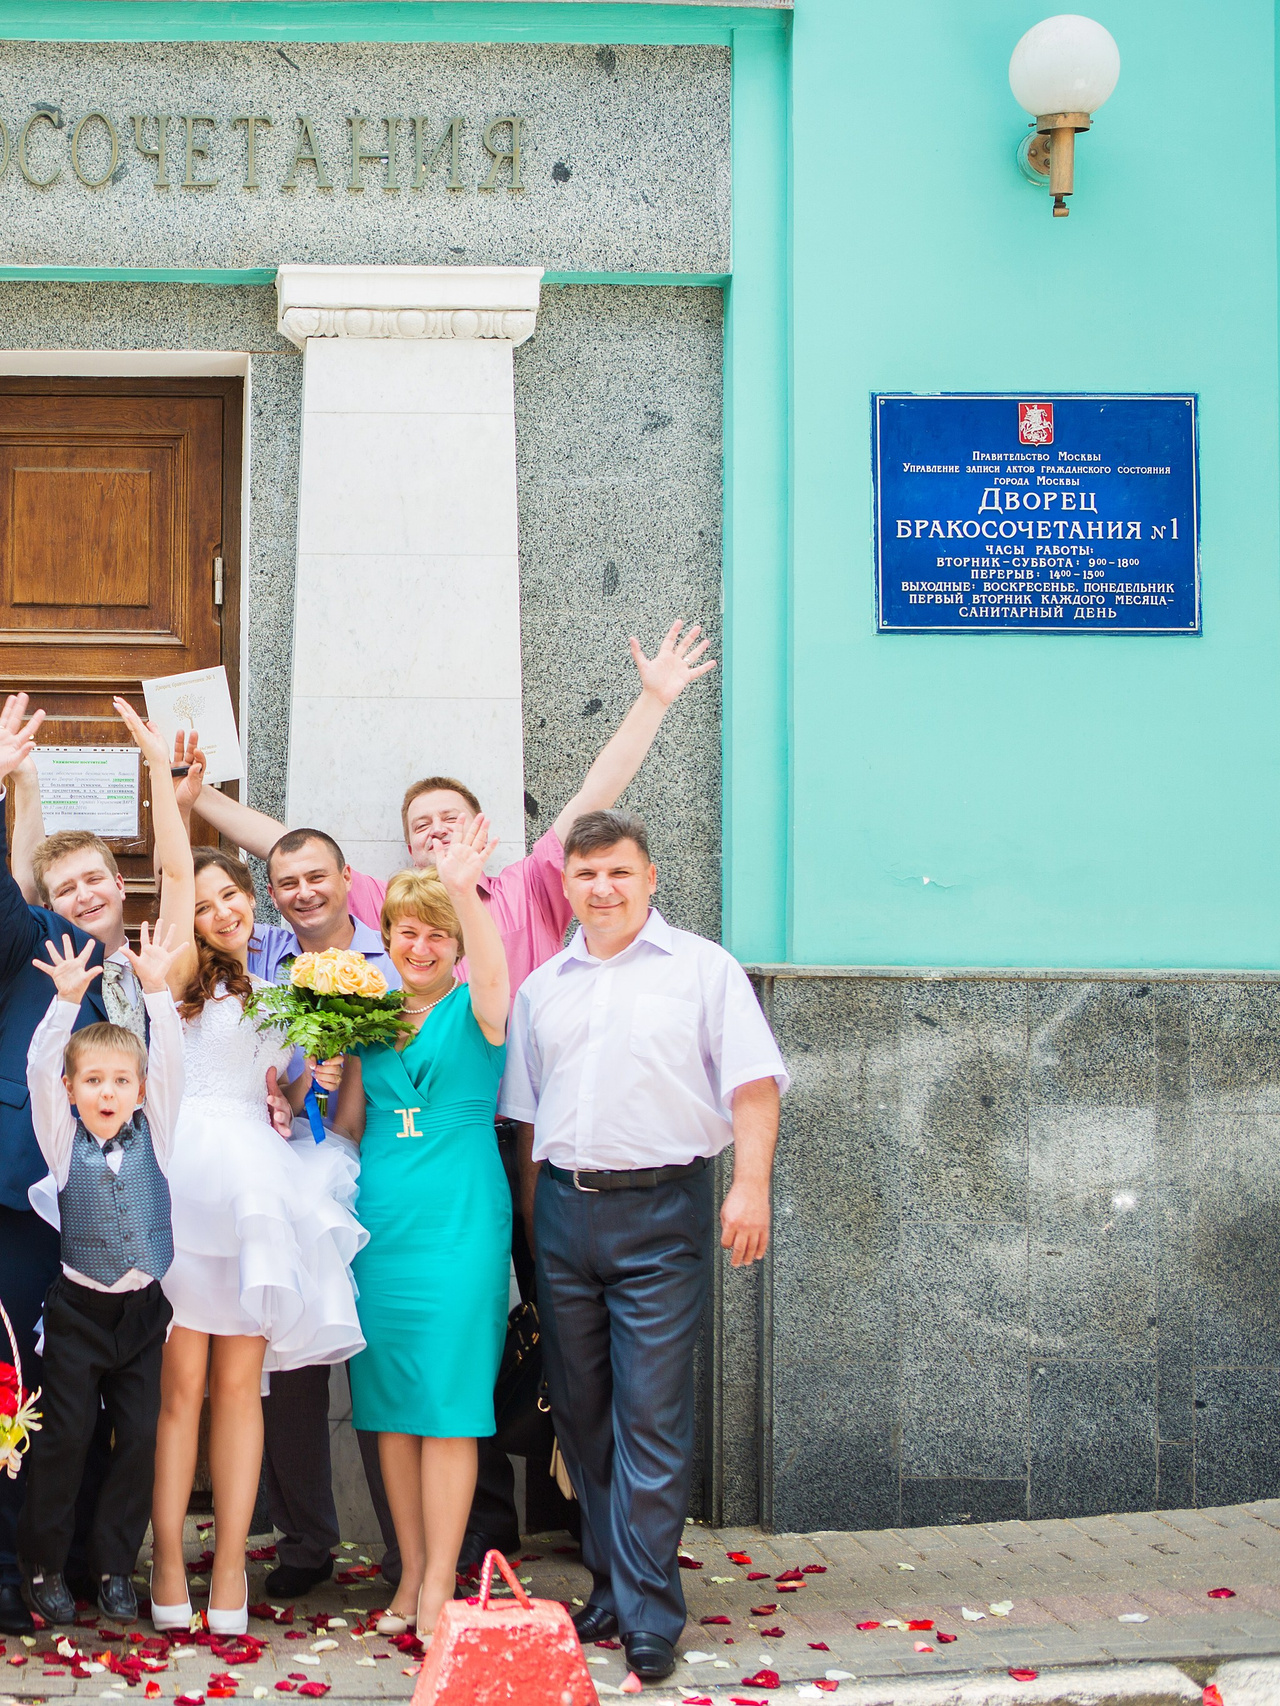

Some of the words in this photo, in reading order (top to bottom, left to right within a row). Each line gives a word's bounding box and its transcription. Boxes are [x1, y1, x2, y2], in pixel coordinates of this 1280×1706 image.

[896, 519, 1142, 540] БРАКОСОЧЕТАНИЯ
[985, 544, 1025, 555] ЧАСЫ
[1035, 545, 1094, 556] РАБОТЫ:
[901, 581, 976, 594] ВЫХОДНЫЕ:
[1083, 582, 1175, 594] ПОНЕДЕЛЬНИК
[909, 592, 964, 604] ПЕРВЫЙ
[972, 594, 1033, 605] ВТОРНИК
[1040, 594, 1106, 606] КАЖДОГО
[958, 605, 1064, 618] САНИТАРНЫЙ
[1073, 606, 1118, 620] ДЕНЬ
